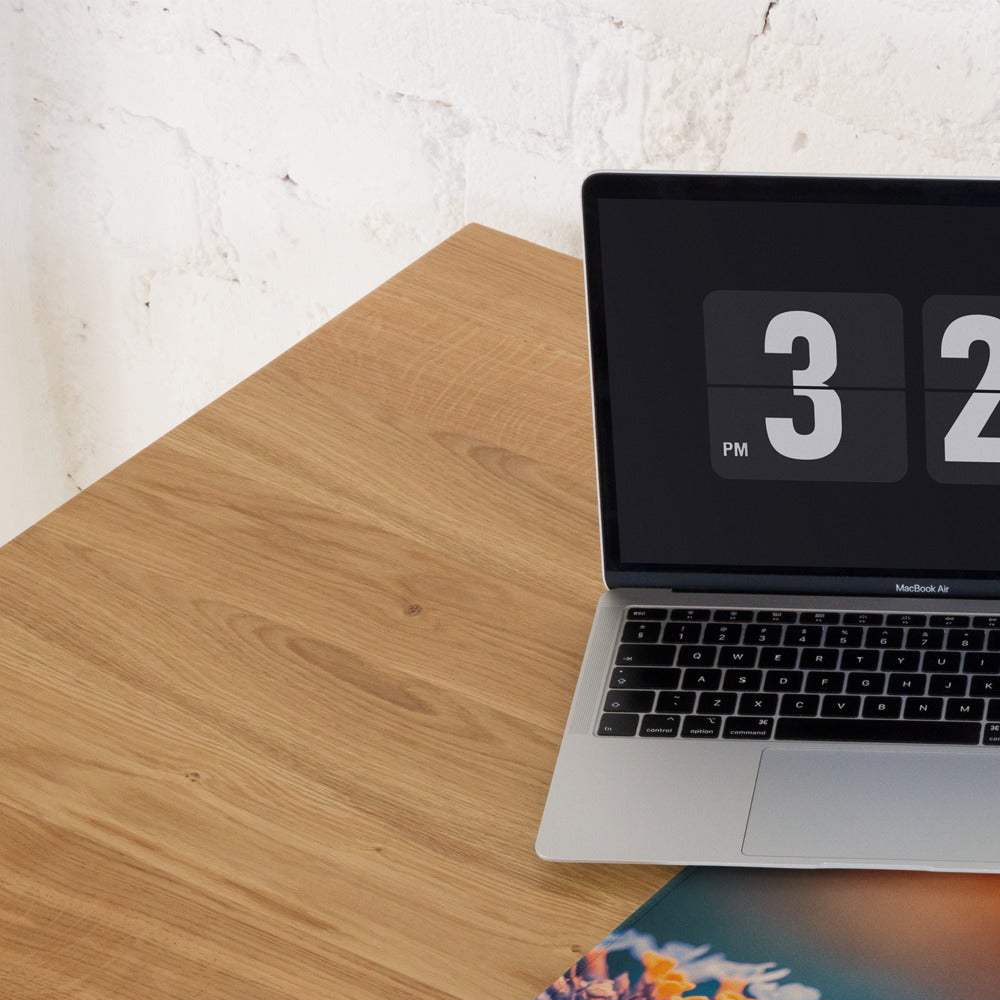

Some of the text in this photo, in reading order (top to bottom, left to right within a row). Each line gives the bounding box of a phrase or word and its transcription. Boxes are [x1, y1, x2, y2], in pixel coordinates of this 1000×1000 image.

[765, 311, 842, 461] 3
[722, 441, 749, 457] PM
[896, 584, 950, 593] MacBook Air
